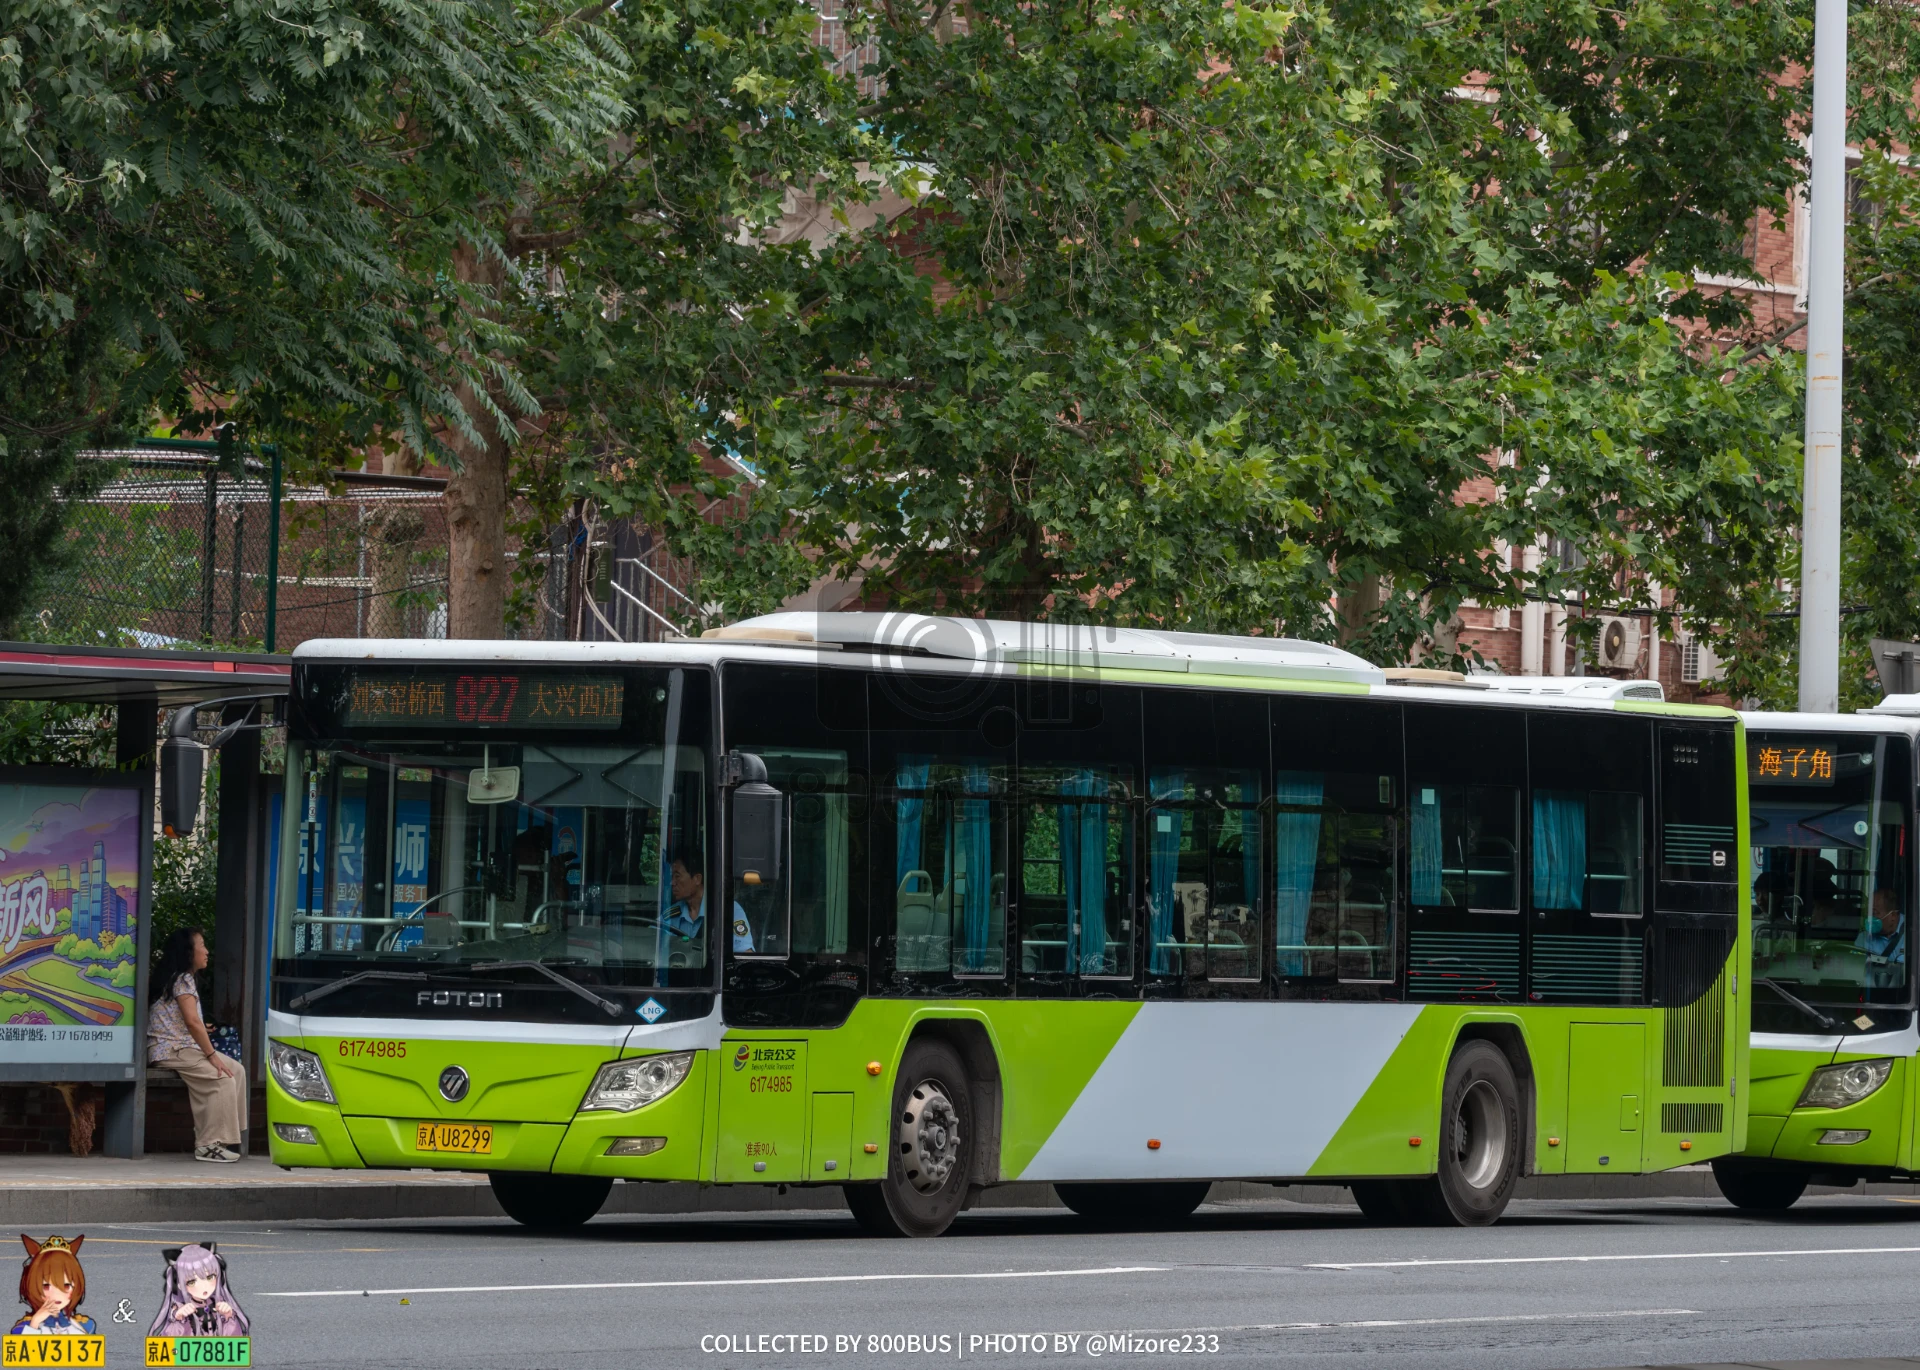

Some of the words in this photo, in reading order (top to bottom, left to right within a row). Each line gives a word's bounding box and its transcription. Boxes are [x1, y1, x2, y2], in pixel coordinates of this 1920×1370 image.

[350, 681, 446, 715] 刘家窑桥西
[455, 675, 519, 722] 827
[528, 682, 624, 717] 大兴西庄
[1759, 747, 1831, 778] 海子角
[417, 991, 502, 1008] FOTON
[642, 1007, 661, 1015] LNG
[339, 1040, 406, 1058] 6174985
[752, 1048, 796, 1061] 北京公交
[750, 1076, 792, 1093] 6174985
[744, 1141, 777, 1157] 准乘90人
